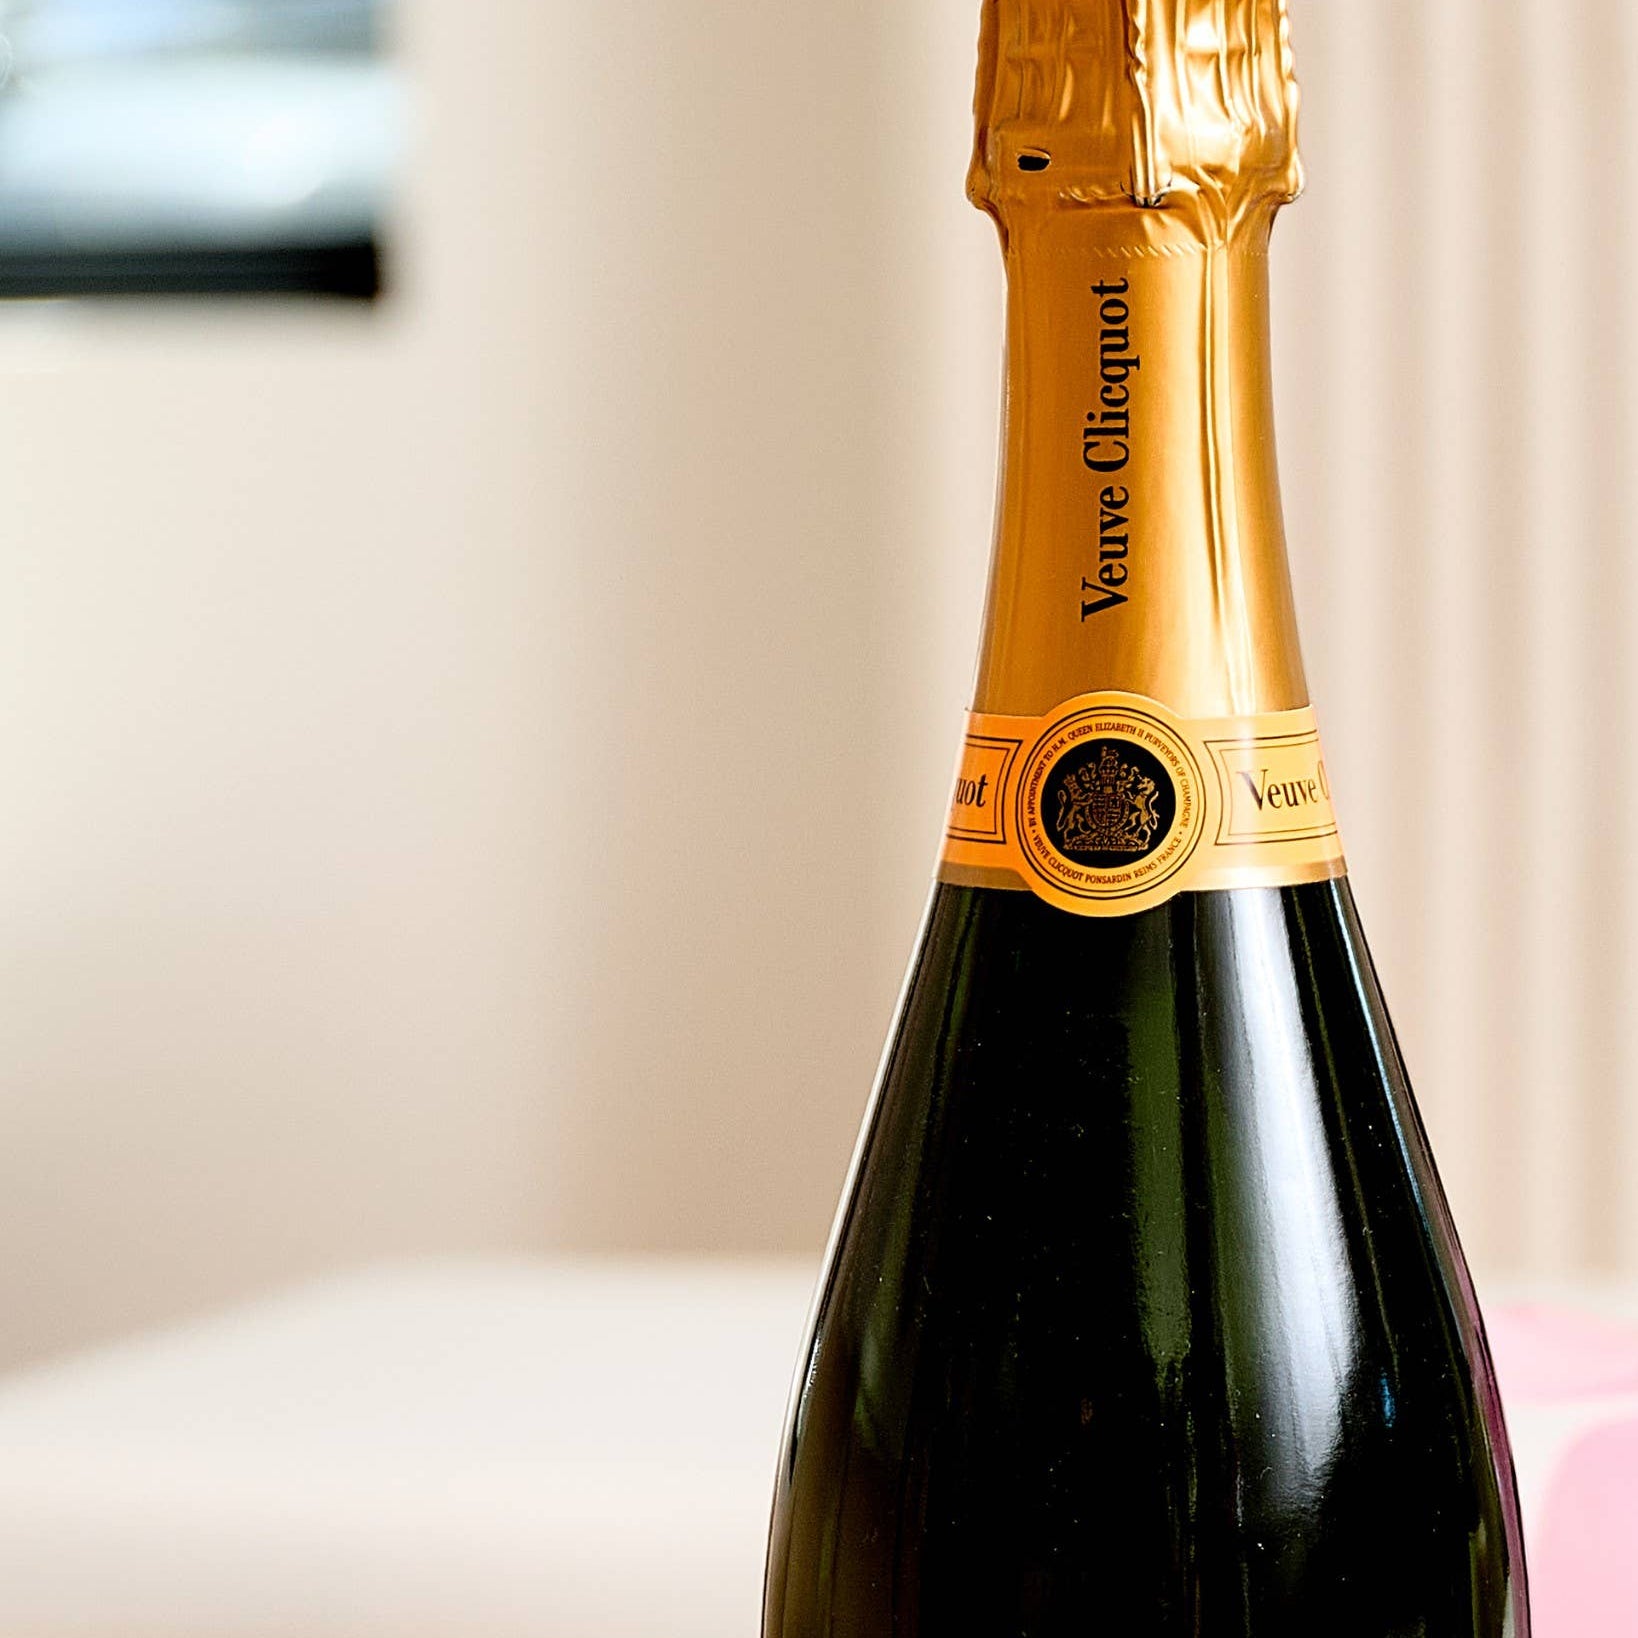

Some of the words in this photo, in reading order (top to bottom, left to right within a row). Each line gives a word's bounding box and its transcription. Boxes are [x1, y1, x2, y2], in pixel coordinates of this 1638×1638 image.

[1083, 277, 1140, 473] Clicquot
[1081, 485, 1129, 622] Veuve
[1067, 724, 1093, 740] QUEEN
[1095, 722, 1136, 735] ELIZABETH
[1144, 732, 1180, 767] PURVEYORS
[1236, 769, 1317, 811] Veuve
[1047, 856, 1084, 881] CLICQUOT
[1085, 872, 1132, 884] PONSARDIN
[1133, 861, 1158, 879] REIMS
[1156, 837, 1182, 864] FRANCE
